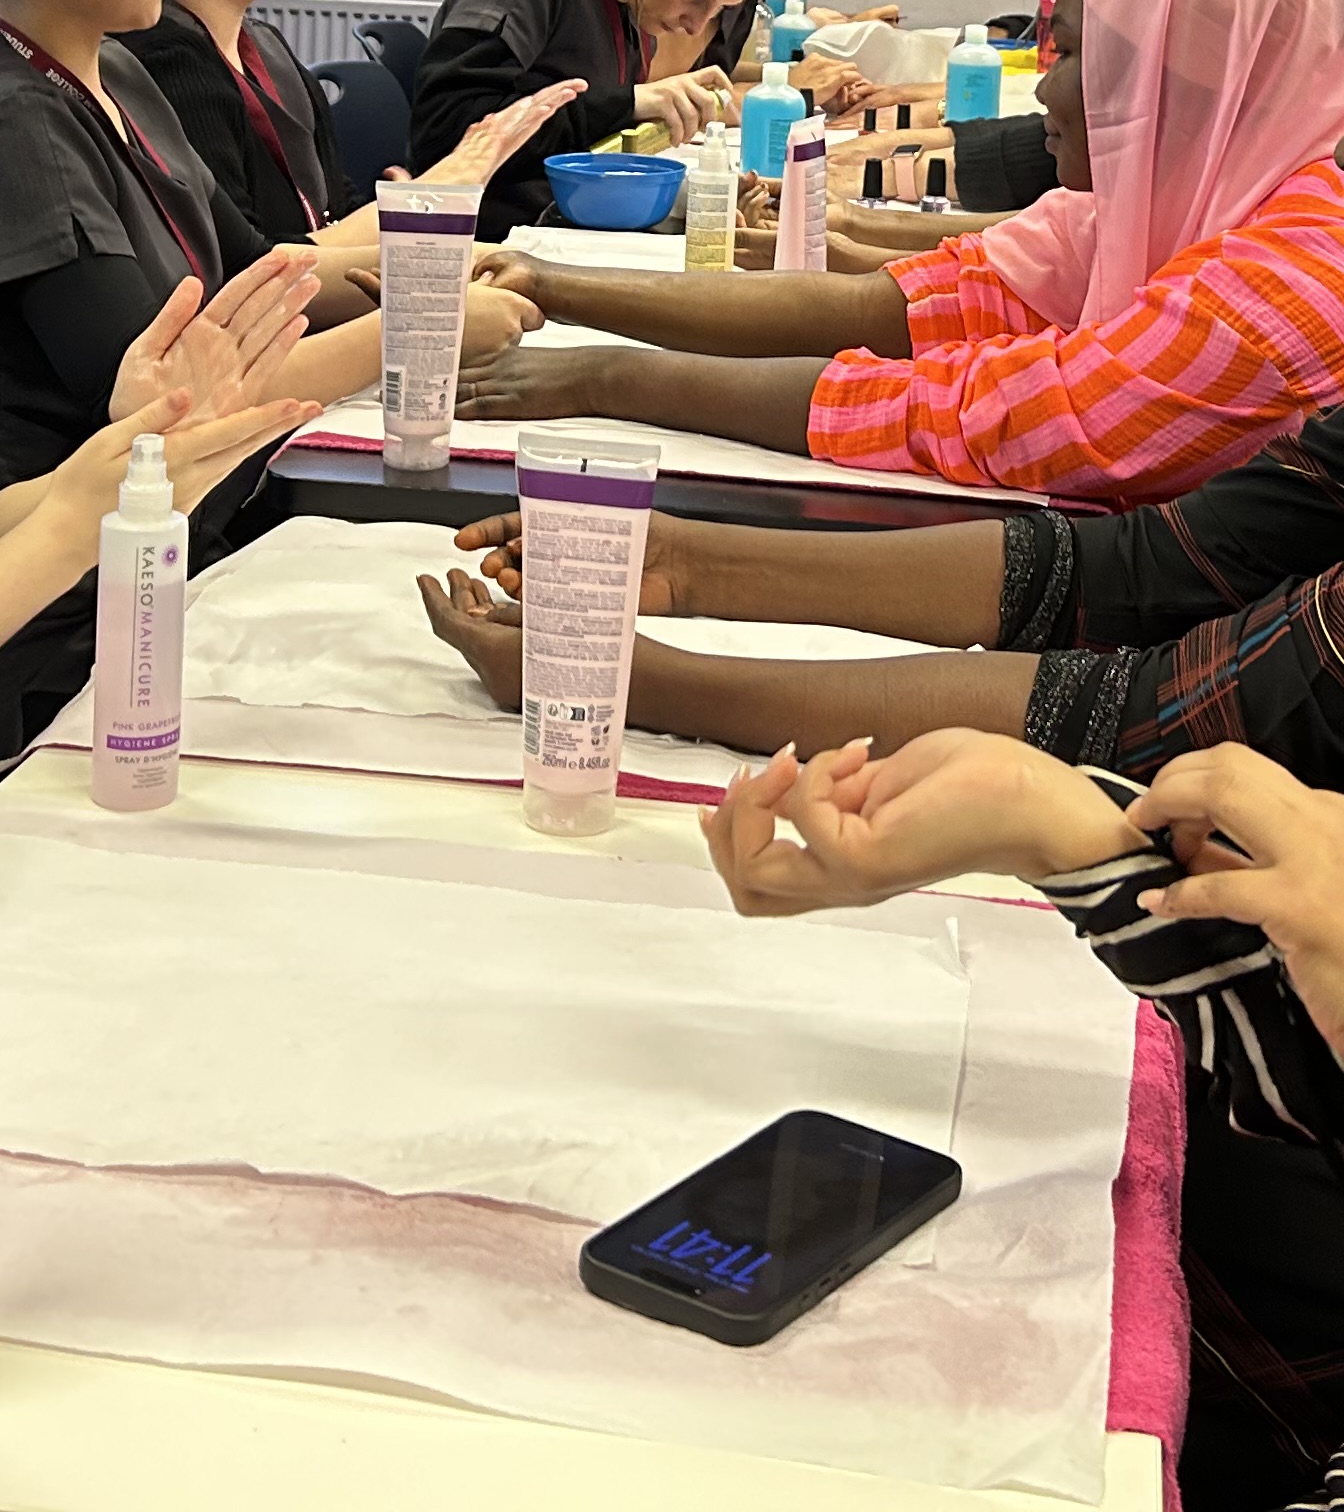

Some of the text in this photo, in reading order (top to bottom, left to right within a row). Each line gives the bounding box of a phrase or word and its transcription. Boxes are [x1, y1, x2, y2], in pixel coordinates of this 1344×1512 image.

[136, 545, 156, 709] KAESO MANICURE
[112, 721, 134, 732] PINK
[109, 737, 157, 748] HYGIENE
[114, 755, 141, 764] SPRAY
[542, 752, 568, 769] 250ml
[647, 1220, 774, 1285] 11:41
